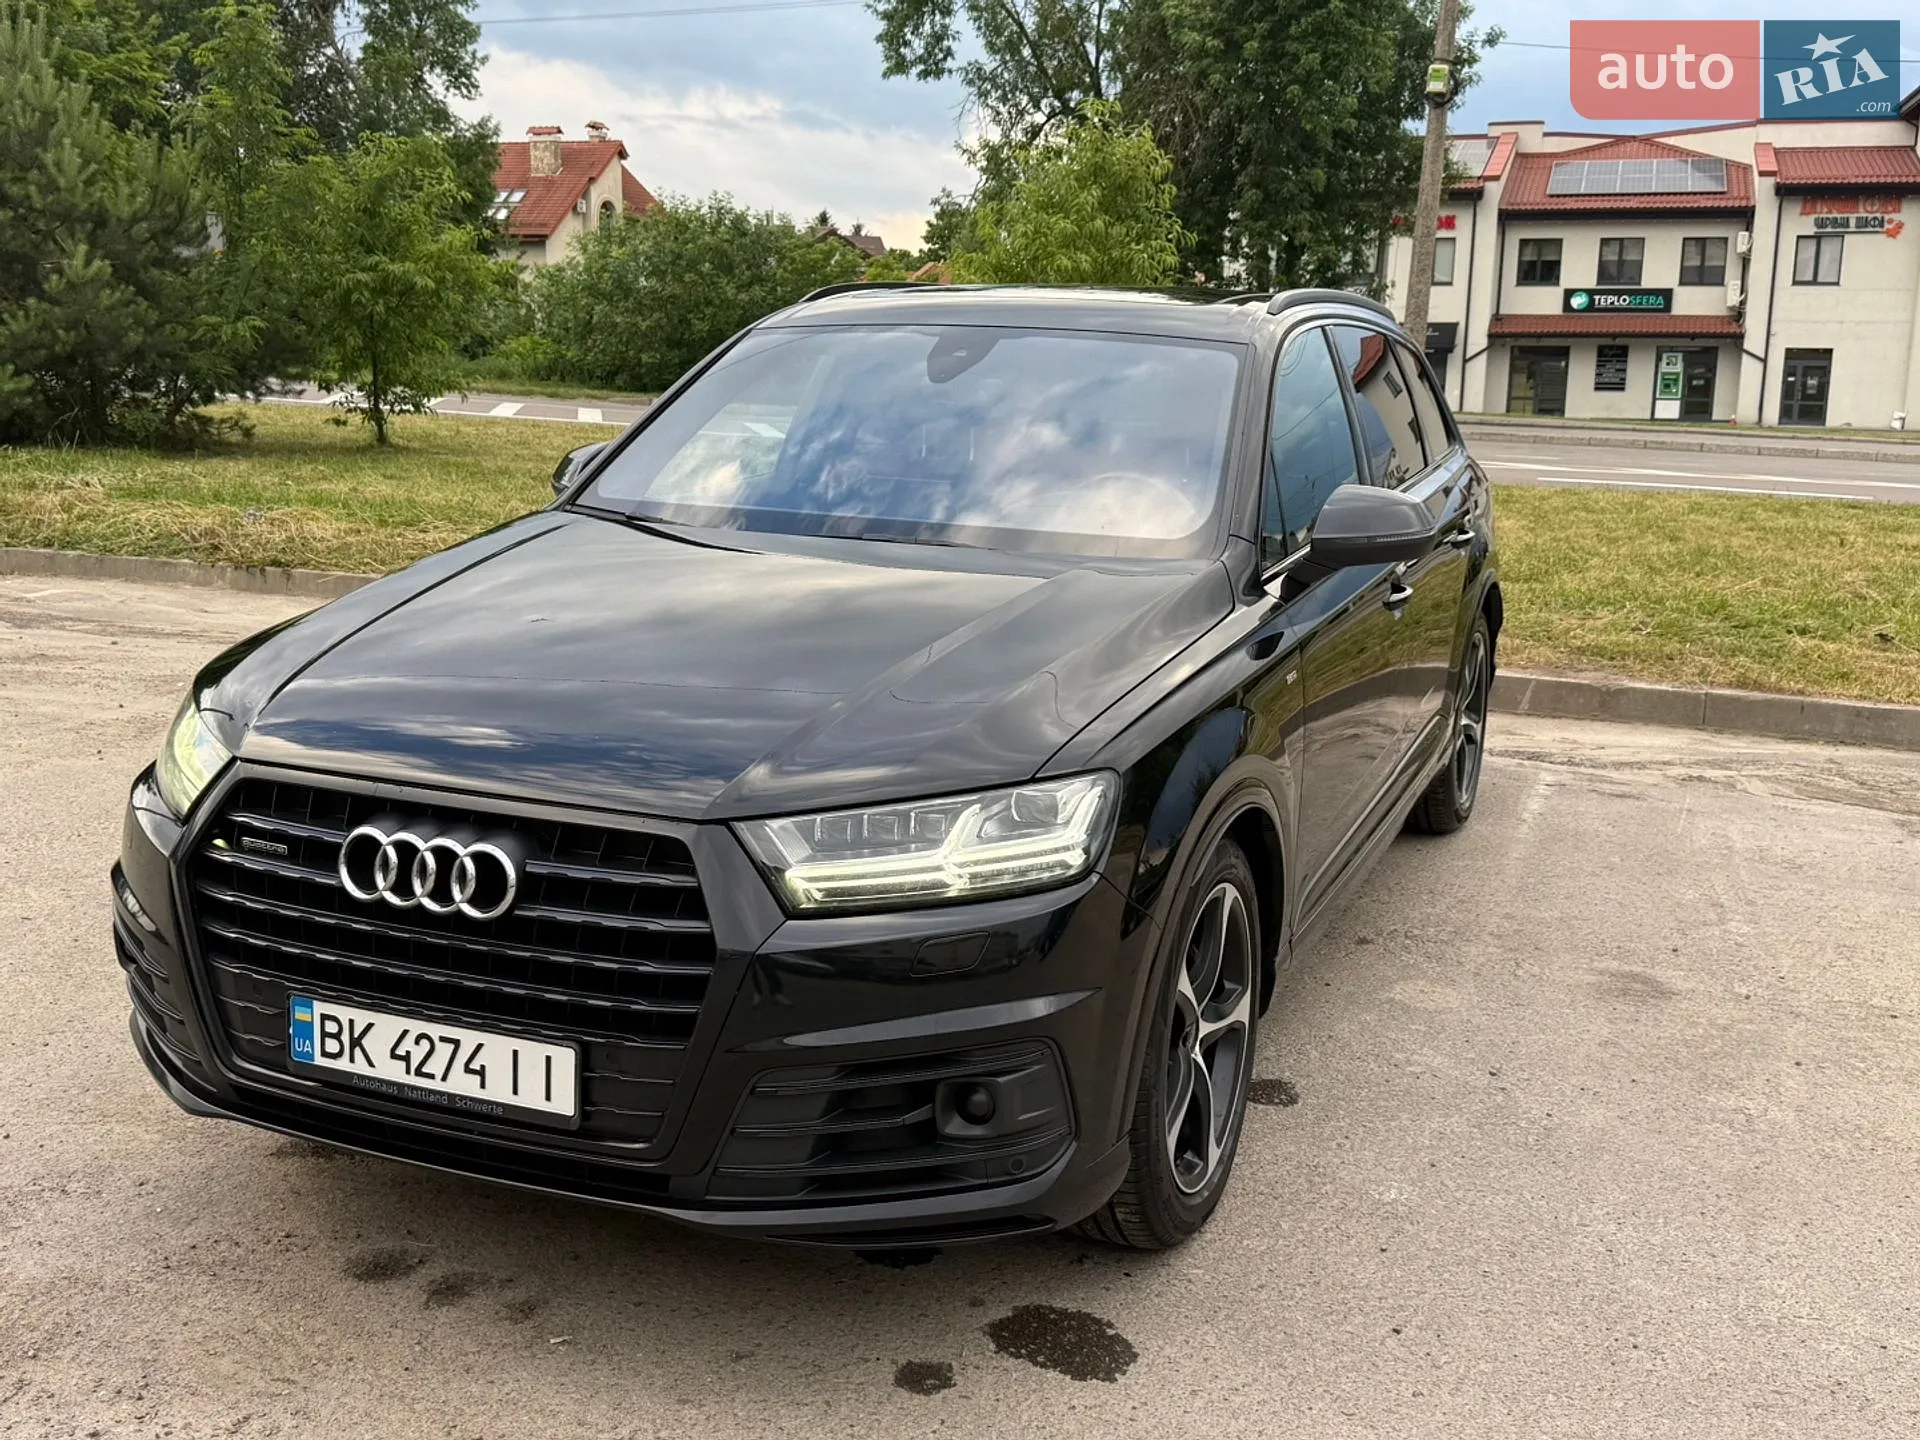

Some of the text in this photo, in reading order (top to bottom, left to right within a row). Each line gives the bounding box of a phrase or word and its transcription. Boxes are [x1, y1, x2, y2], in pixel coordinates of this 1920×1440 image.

[1593, 294, 1664, 306] TEPLOSFERA
[295, 1040, 313, 1055] UA
[319, 1012, 376, 1069] BK
[389, 1028, 487, 1090] 4274
[352, 1075, 505, 1116] Autohaus Nattland Schwerte
